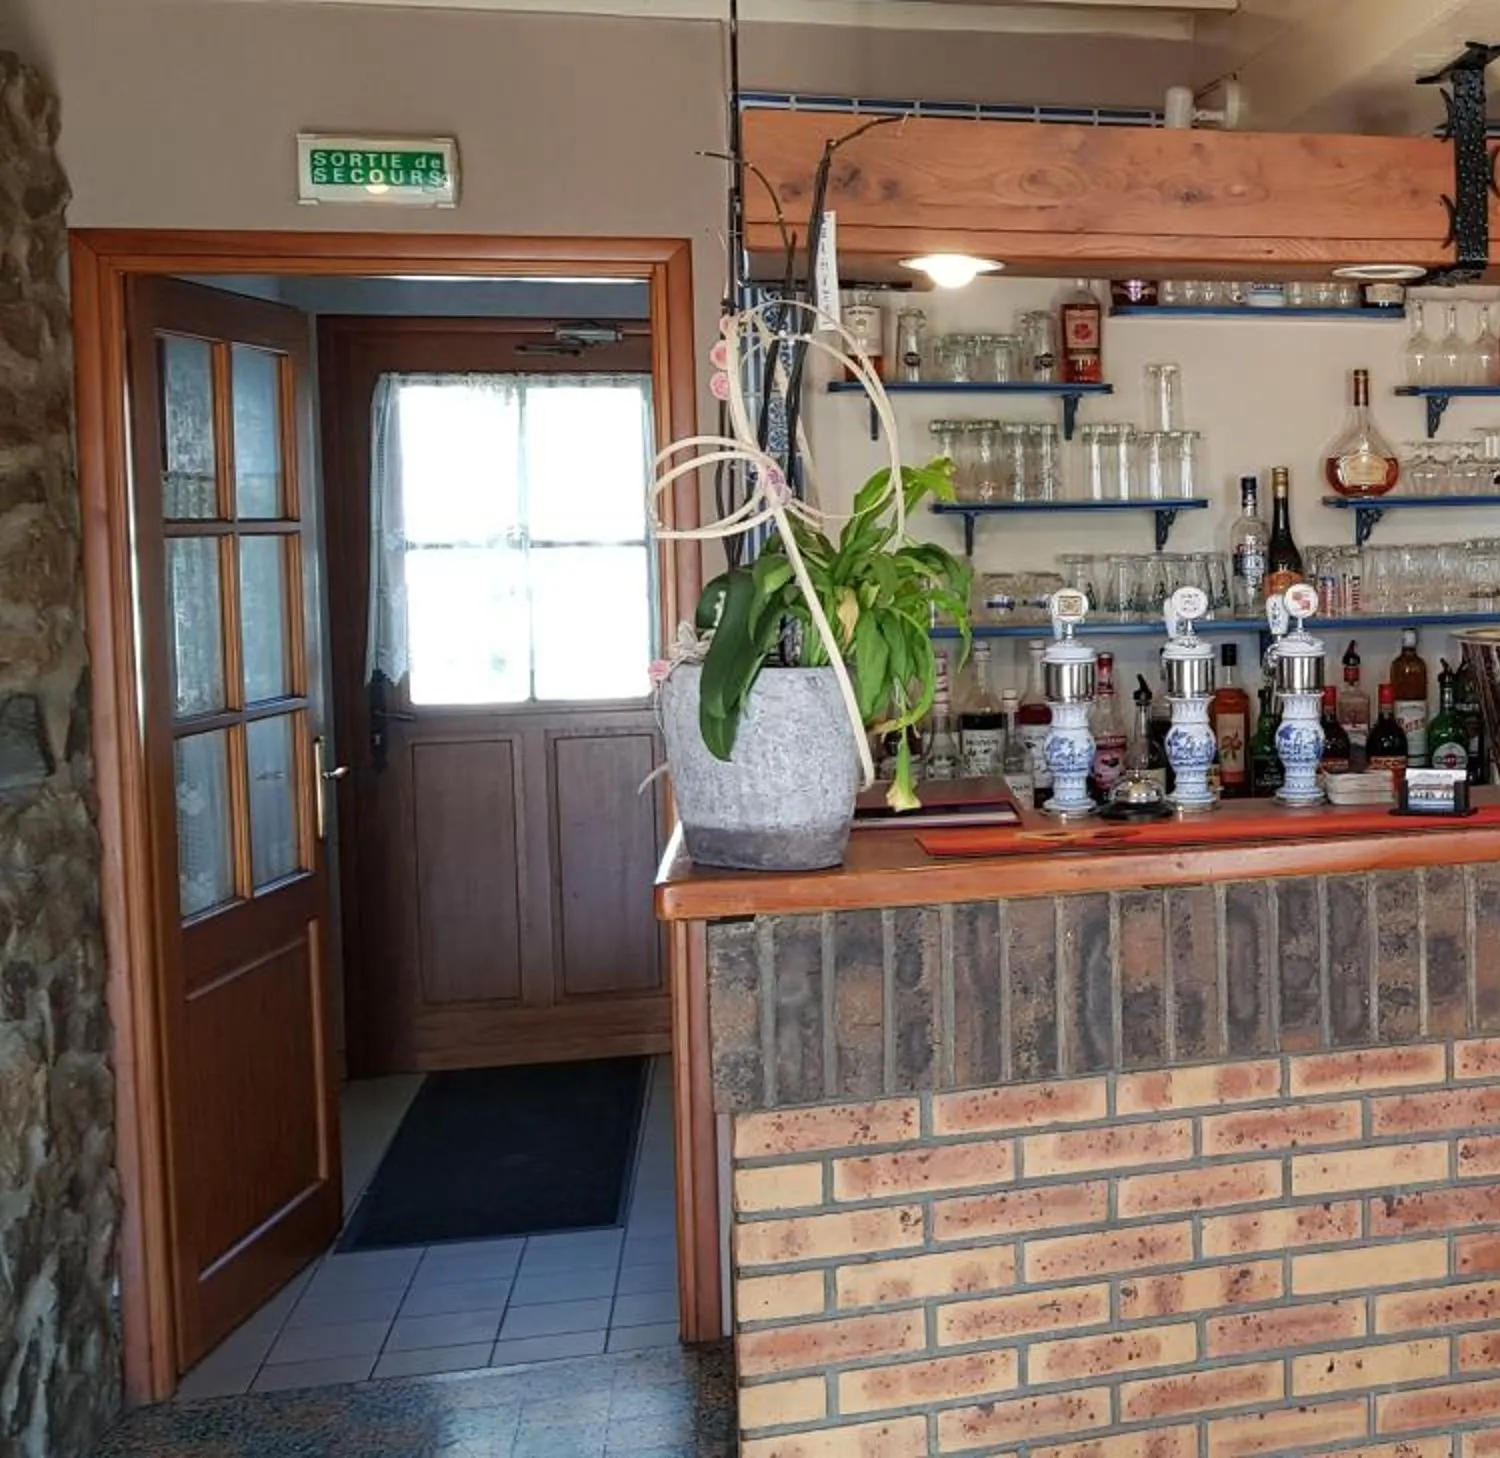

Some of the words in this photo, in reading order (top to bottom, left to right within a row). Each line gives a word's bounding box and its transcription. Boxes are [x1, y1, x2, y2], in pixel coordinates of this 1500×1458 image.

[313, 152, 401, 169] SORTIE
[415, 155, 441, 169] de
[313, 168, 444, 186] SECOURS
